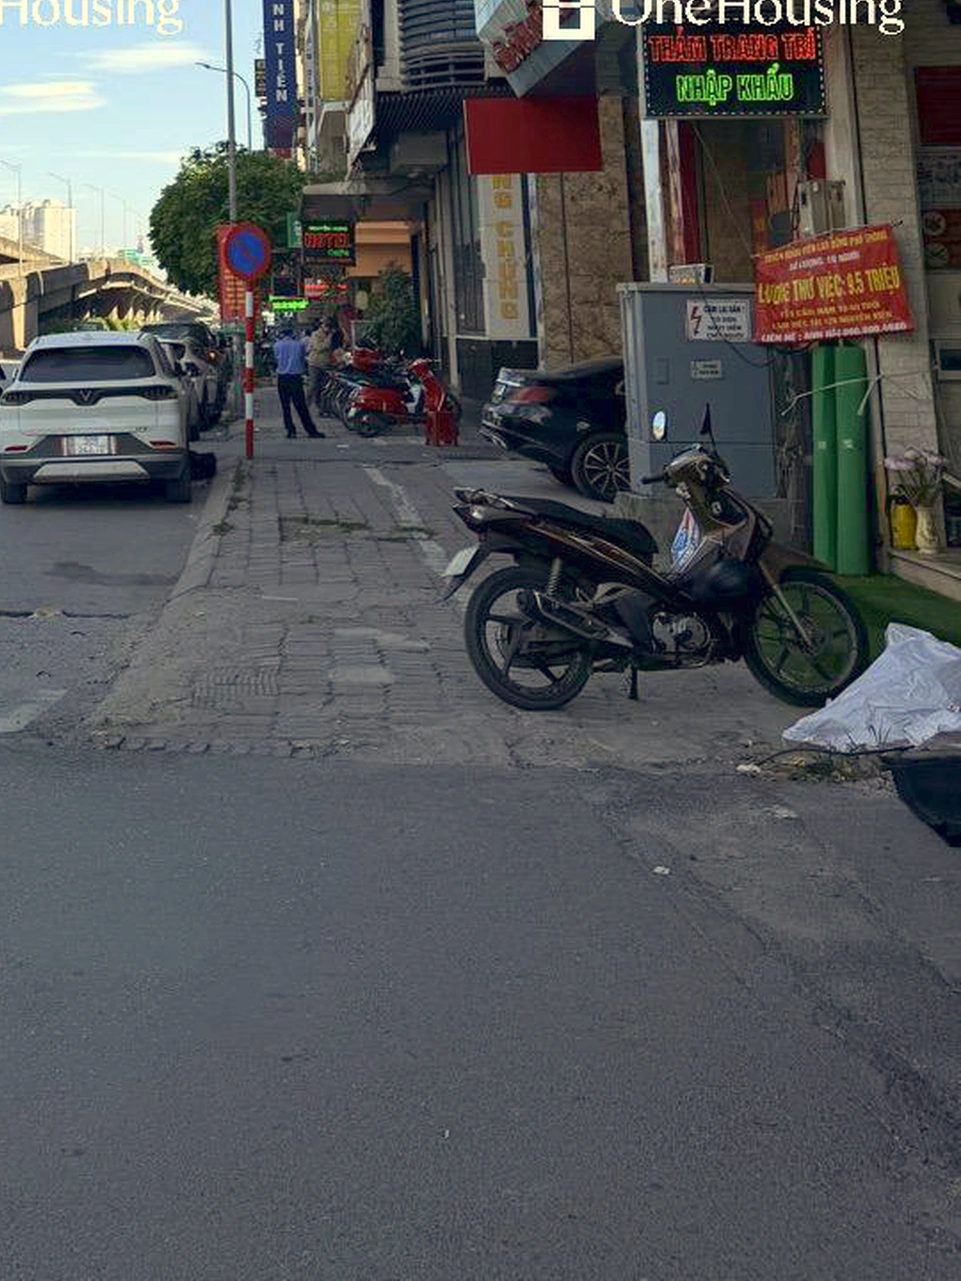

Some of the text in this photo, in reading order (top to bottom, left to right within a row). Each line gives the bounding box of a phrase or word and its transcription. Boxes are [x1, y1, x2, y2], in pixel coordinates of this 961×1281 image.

[649, 27, 707, 62] THẢM
[710, 33, 779, 62] TRANG
[676, 63, 793, 106] NHẬP KHẨU
[867, 262, 900, 295] TRIỆU
